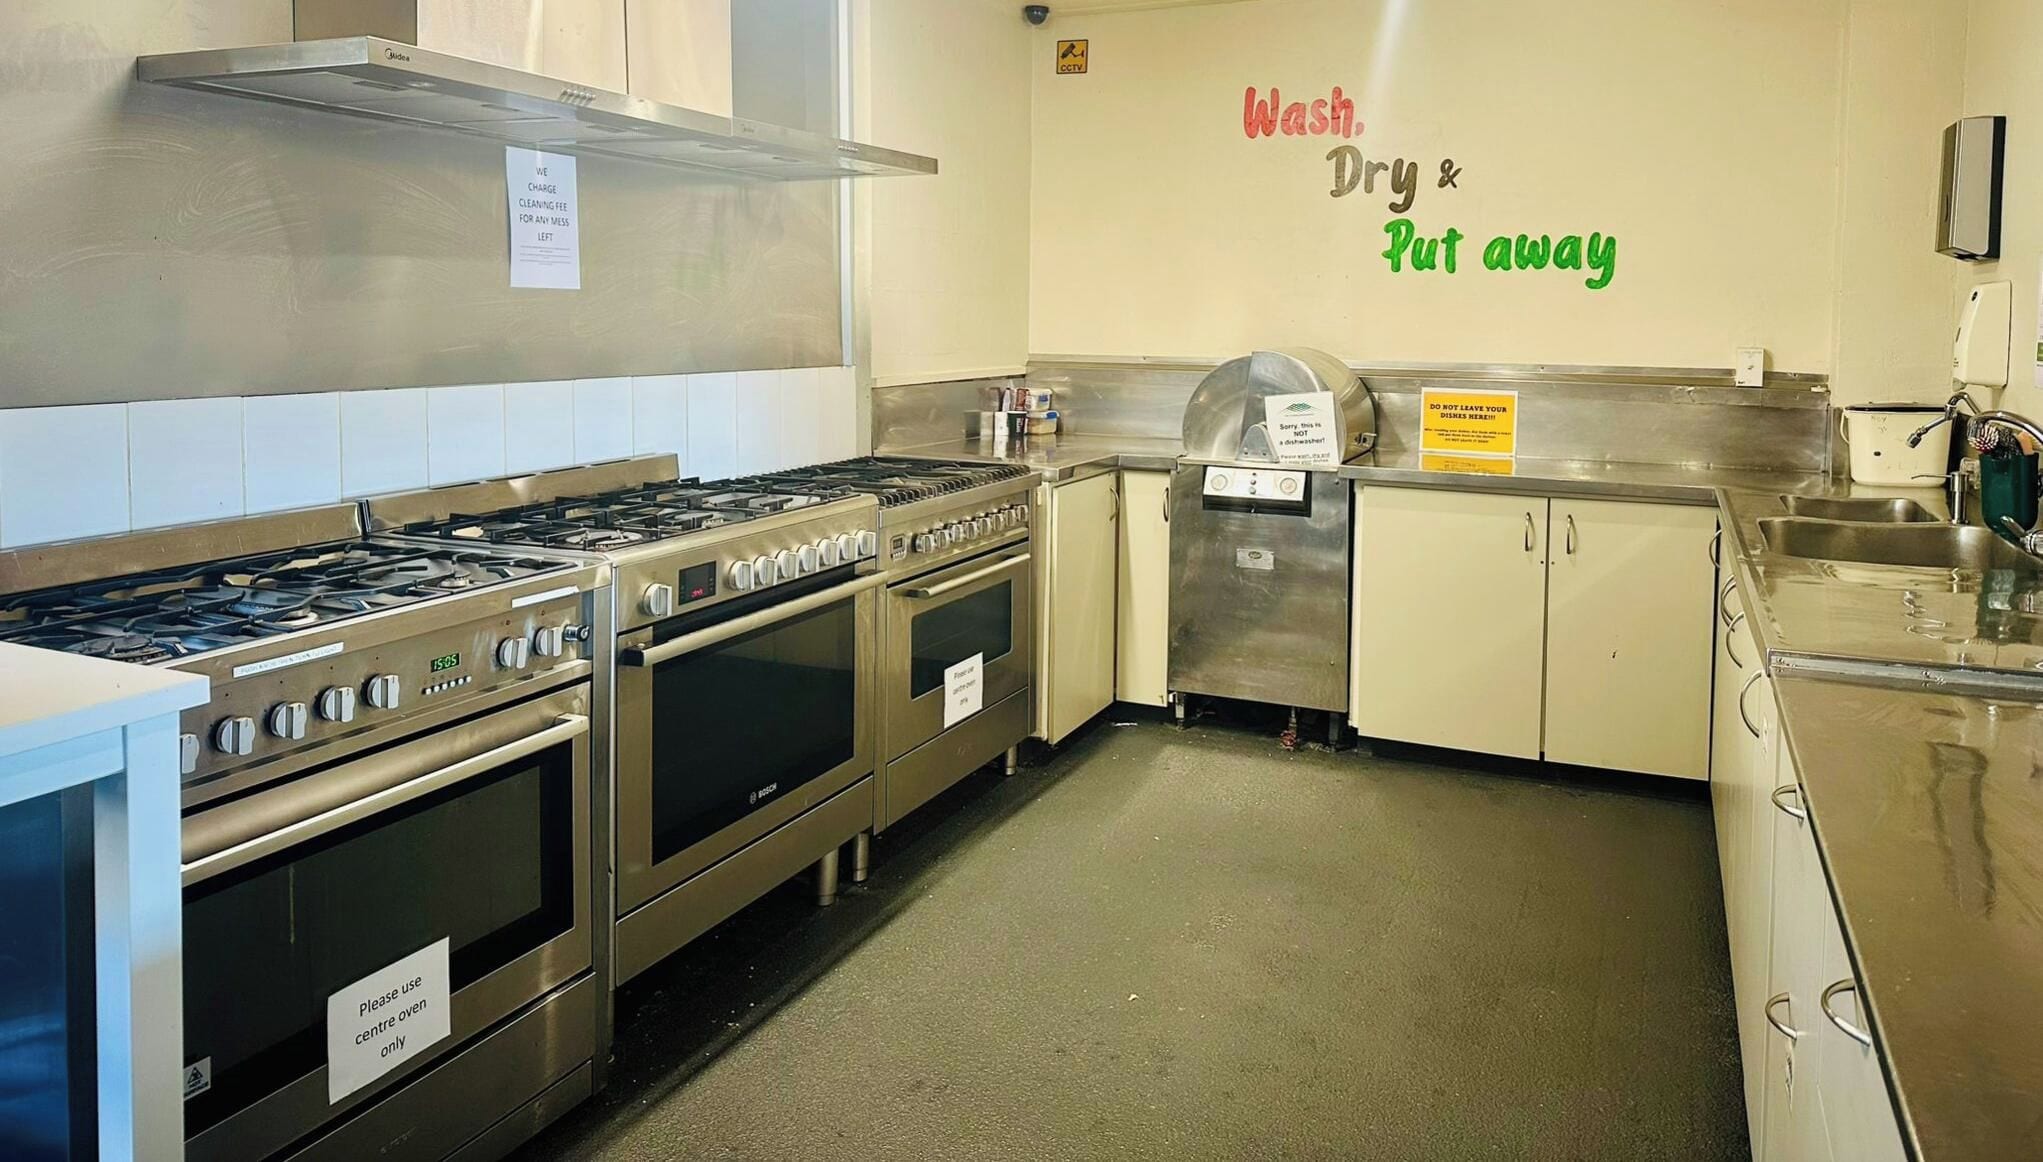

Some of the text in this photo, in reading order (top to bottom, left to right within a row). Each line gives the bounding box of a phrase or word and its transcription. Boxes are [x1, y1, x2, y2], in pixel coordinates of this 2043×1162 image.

[1060, 64, 1083, 72] CCTV
[1243, 85, 1365, 139] Wash,
[536, 167, 548, 177] WE
[1325, 144, 1464, 214] Dry &
[528, 182, 557, 194] CHARGE
[518, 198, 568, 212] CLEANING FEE
[519, 213, 570, 227] FOR ANY MESS
[537, 232, 553, 242] LEFT
[1381, 218, 1617, 290] Put away
[1440, 412, 1496, 421] DISHES HERE!!!
[758, 782, 777, 799] BOSCH
[359, 976, 422, 1017] Please use
[355, 998, 427, 1045] centre oven
[380, 1034, 406, 1058] only
